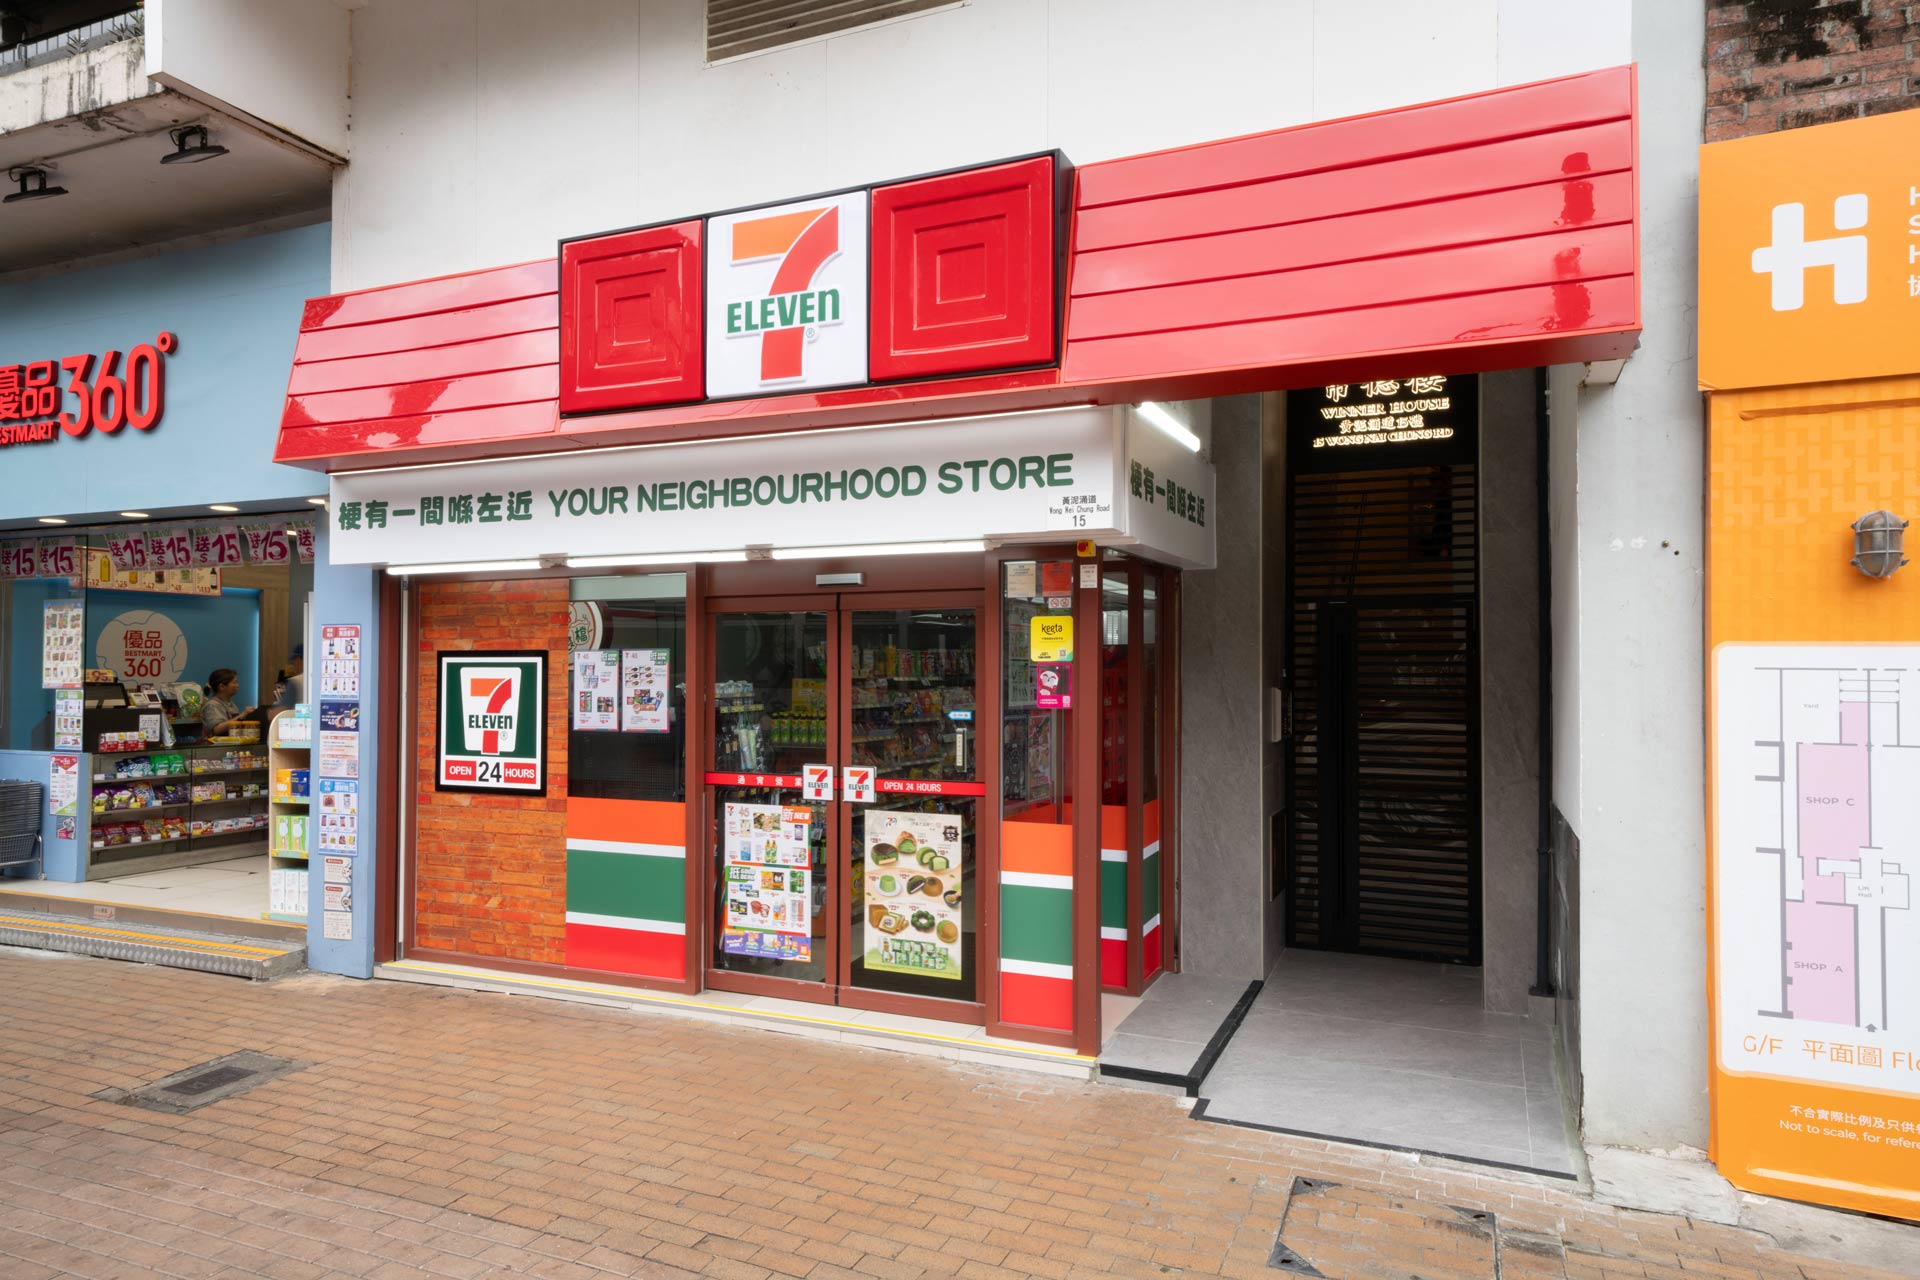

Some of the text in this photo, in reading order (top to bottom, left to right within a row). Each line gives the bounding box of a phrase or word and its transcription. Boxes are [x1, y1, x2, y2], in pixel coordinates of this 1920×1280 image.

[732, 205, 839, 381] 7
[1320, 397, 1451, 420] WINNER HOUSE
[1325, 435, 1364, 447] WONG
[1388, 430, 1433, 442] CHUNG
[1433, 428, 1454, 439] RD
[338, 453, 1074, 531] 梗有一間喺左近 YOUR NEIGHBOURHOOD STORE
[1072, 514, 1086, 527] 15
[49, 545, 74, 574] 15
[123, 538, 146, 567] 15
[166, 536, 191, 566] 15
[211, 533, 241, 563] 15
[261, 530, 288, 561] 15
[12, 547, 35, 576] 15
[124, 630, 162, 648] 優品
[1042, 624, 1062, 635] keeta
[471, 678, 512, 753] 7
[449, 761, 535, 782] OPEN 24 HOURS
[809, 768, 828, 797] 7
[849, 770, 869, 799] 7
[884, 781, 942, 792] OPEN 24 HOURS
[1806, 796, 1855, 807] SHOP C
[1793, 961, 1843, 973] SHOP A
[1743, 1034, 1783, 1055] G/F
[1802, 1039, 1882, 1069] 平面圖
[1779, 1119, 1803, 1132] Not
[1806, 1124, 1821, 1135] to
[1823, 1126, 1860, 1142] scale,
[1863, 1131, 1881, 1143] for
